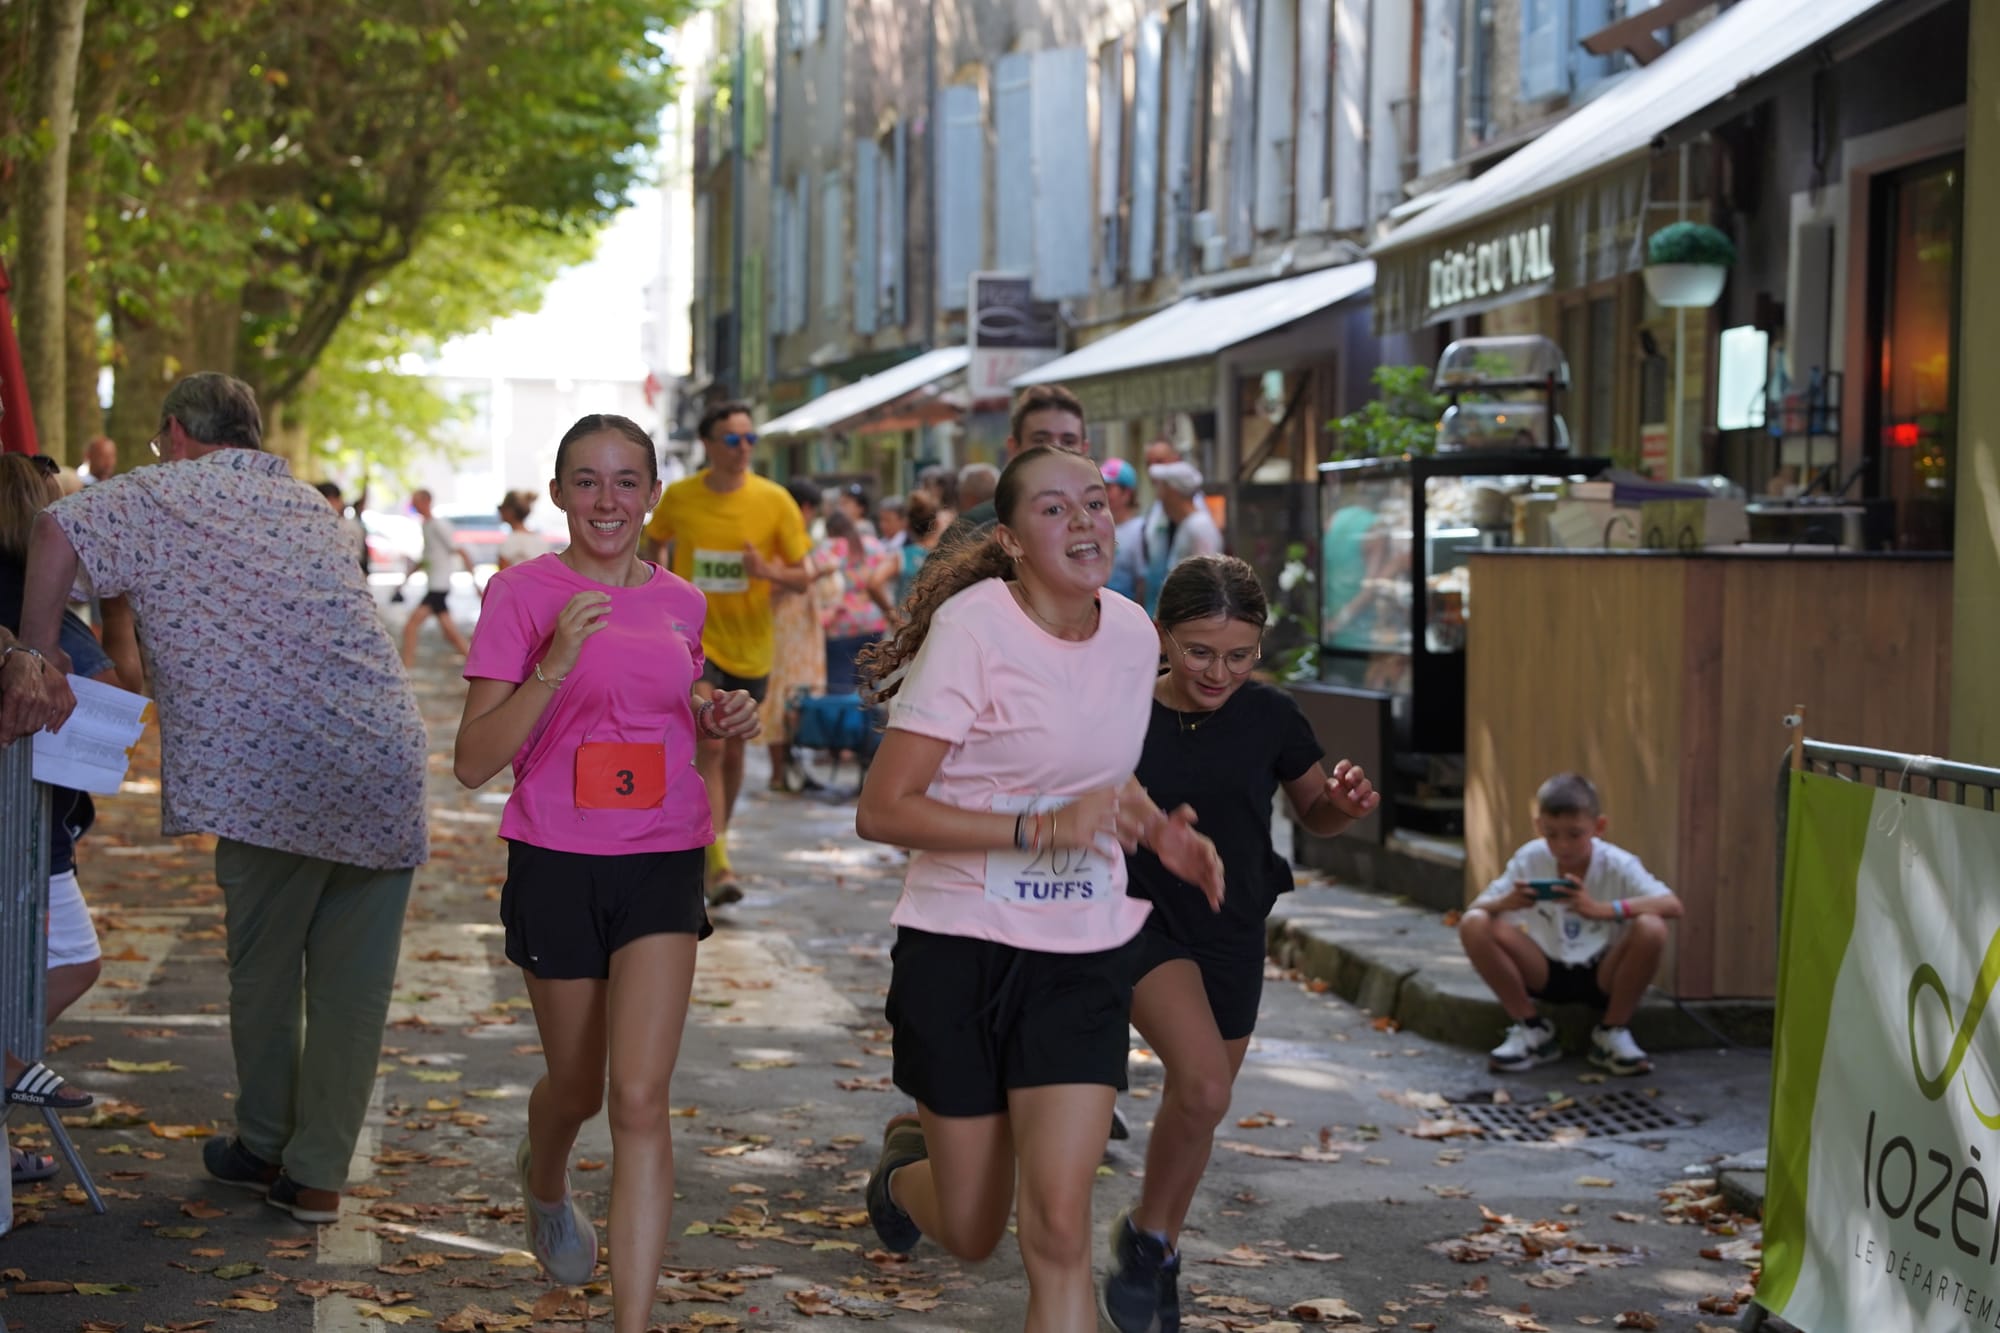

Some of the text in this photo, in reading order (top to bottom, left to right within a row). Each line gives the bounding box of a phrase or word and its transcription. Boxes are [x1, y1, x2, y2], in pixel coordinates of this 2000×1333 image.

[702, 562, 743, 578] 100
[615, 769, 635, 796] 3
[1014, 880, 1094, 900] TUFF'S
[11, 1092, 45, 1104] adidas
[1855, 1233, 1875, 1265] LE
